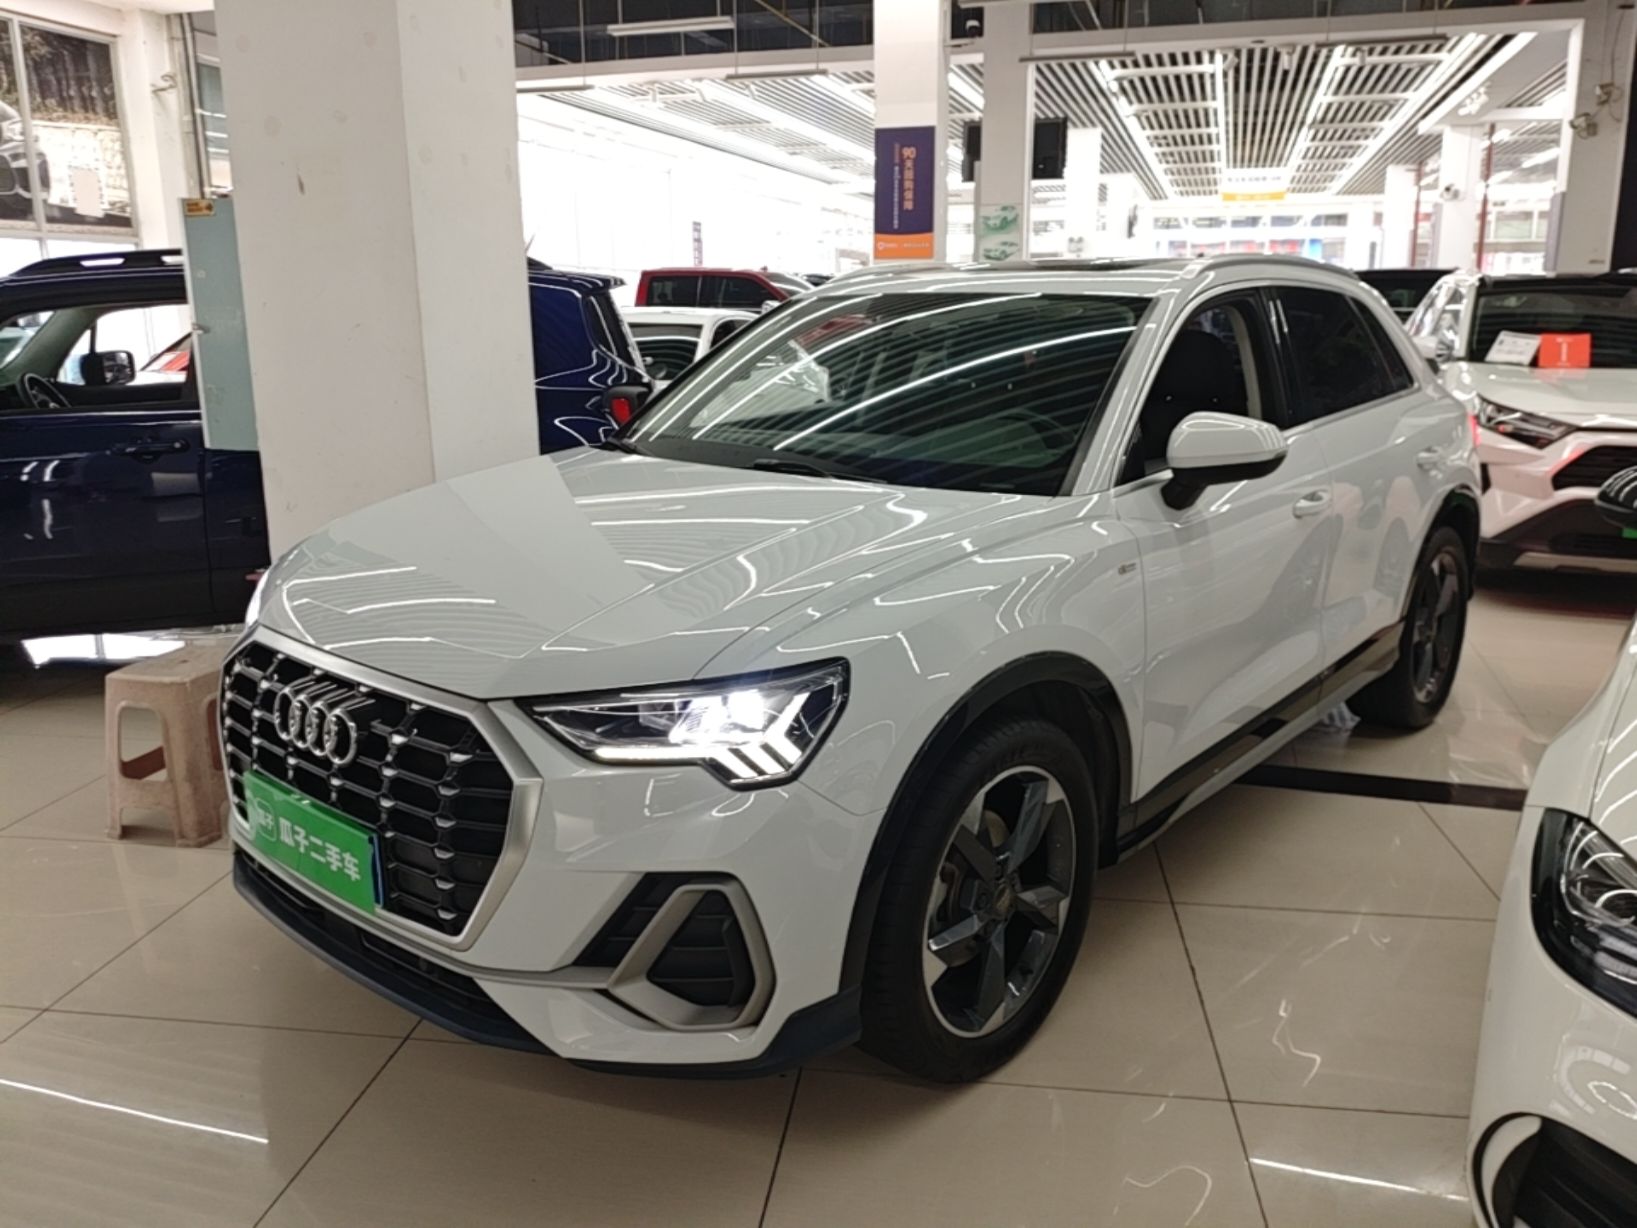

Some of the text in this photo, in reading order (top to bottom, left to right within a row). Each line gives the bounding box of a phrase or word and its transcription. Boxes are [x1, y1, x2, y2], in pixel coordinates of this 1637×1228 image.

[278, 815, 361, 882] 瓜子二手车
